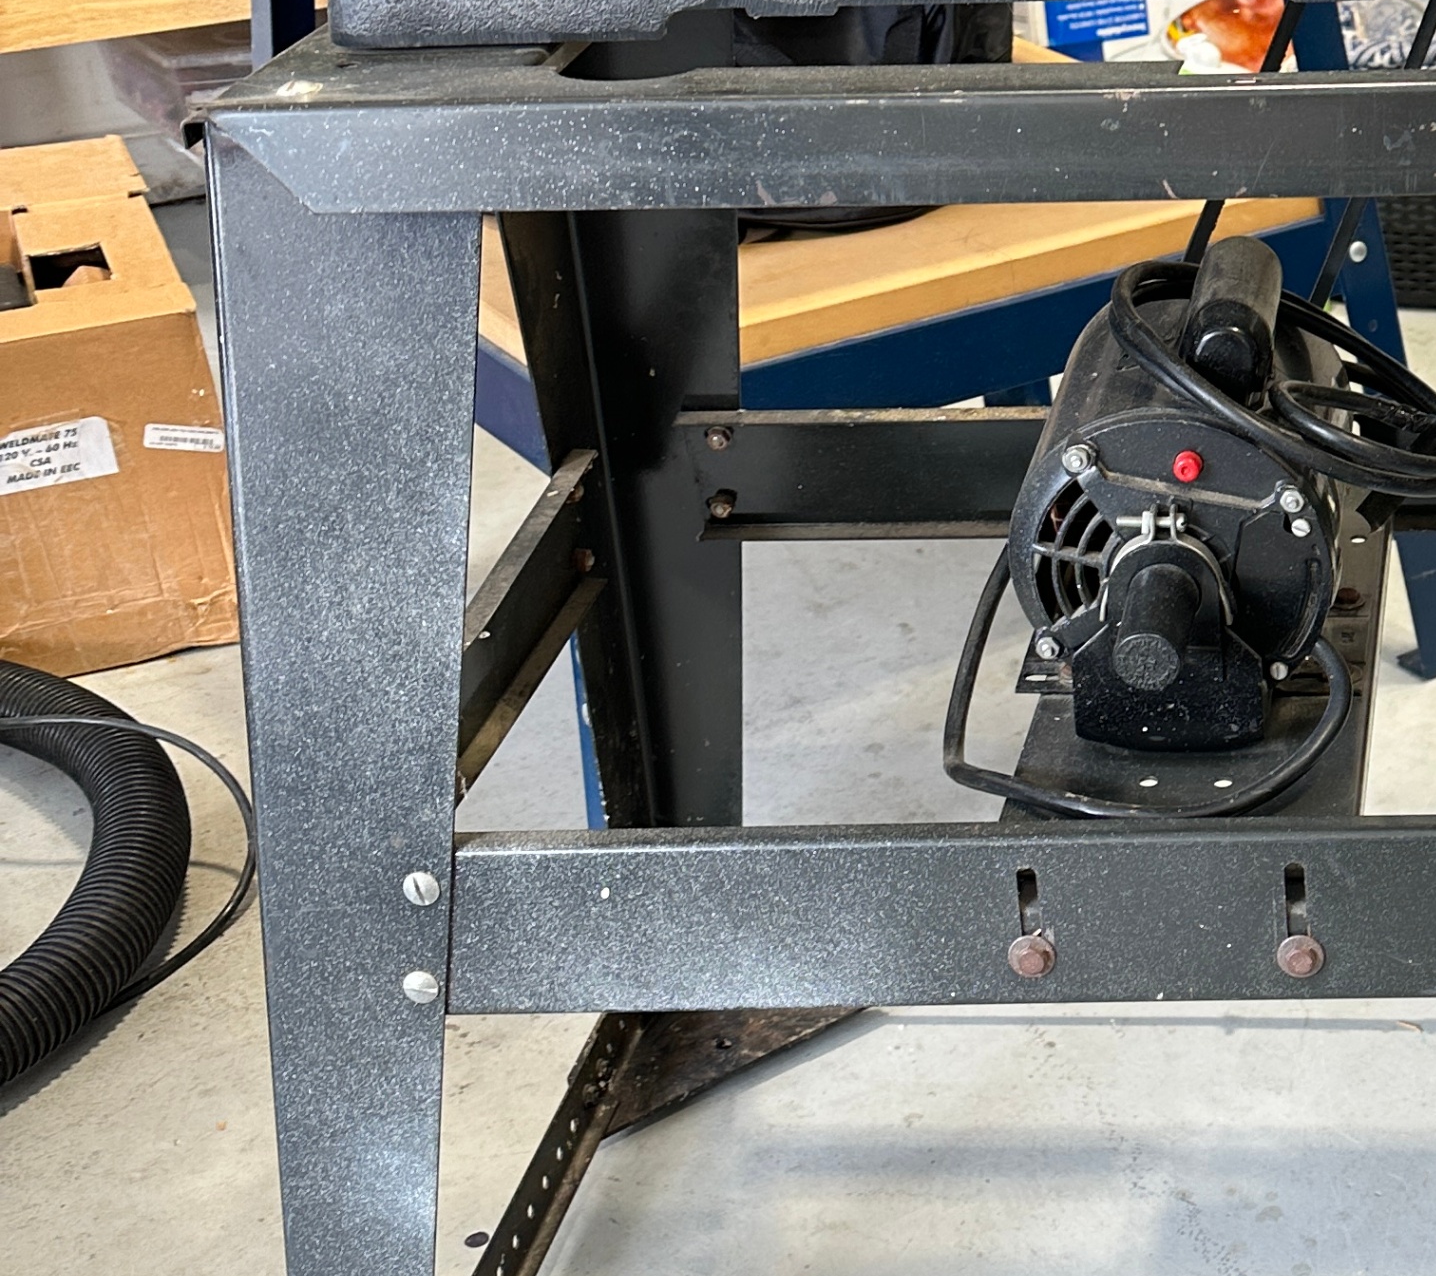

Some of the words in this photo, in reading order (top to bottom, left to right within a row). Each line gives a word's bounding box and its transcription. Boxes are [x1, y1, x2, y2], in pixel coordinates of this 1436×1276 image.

[0, 430, 61, 450] WELDMATE
[64, 427, 78, 438] 75
[45, 443, 60, 453] 60
[30, 456, 52, 467] CSA
[7, 470, 41, 484] MADE
[43, 467, 57, 477] IN
[61, 462, 81, 474] EEC
